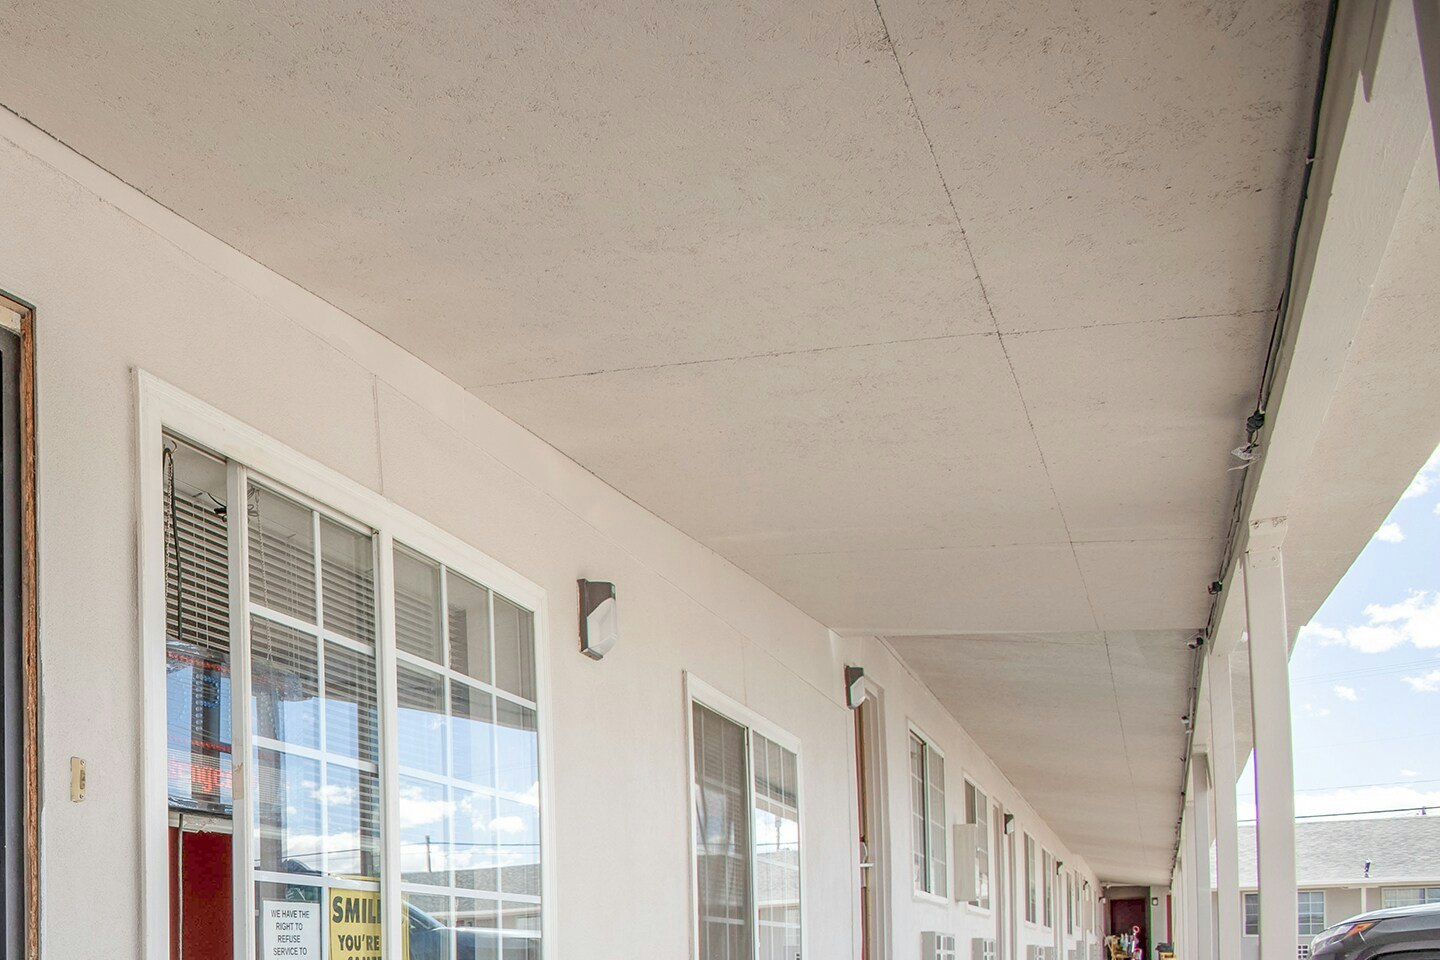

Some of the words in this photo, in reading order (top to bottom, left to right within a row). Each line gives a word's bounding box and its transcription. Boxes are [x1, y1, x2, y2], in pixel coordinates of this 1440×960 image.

[271, 909, 281, 918] WE
[282, 910, 298, 919] HAVE
[299, 910, 310, 919] THE
[275, 922, 294, 931] RIGHT
[295, 923, 303, 931] TO
[277, 934, 301, 943] REFUSE
[337, 934, 380, 951] YOU'RE
[273, 947, 298, 956] SERVICE
[299, 947, 307, 956] TO
